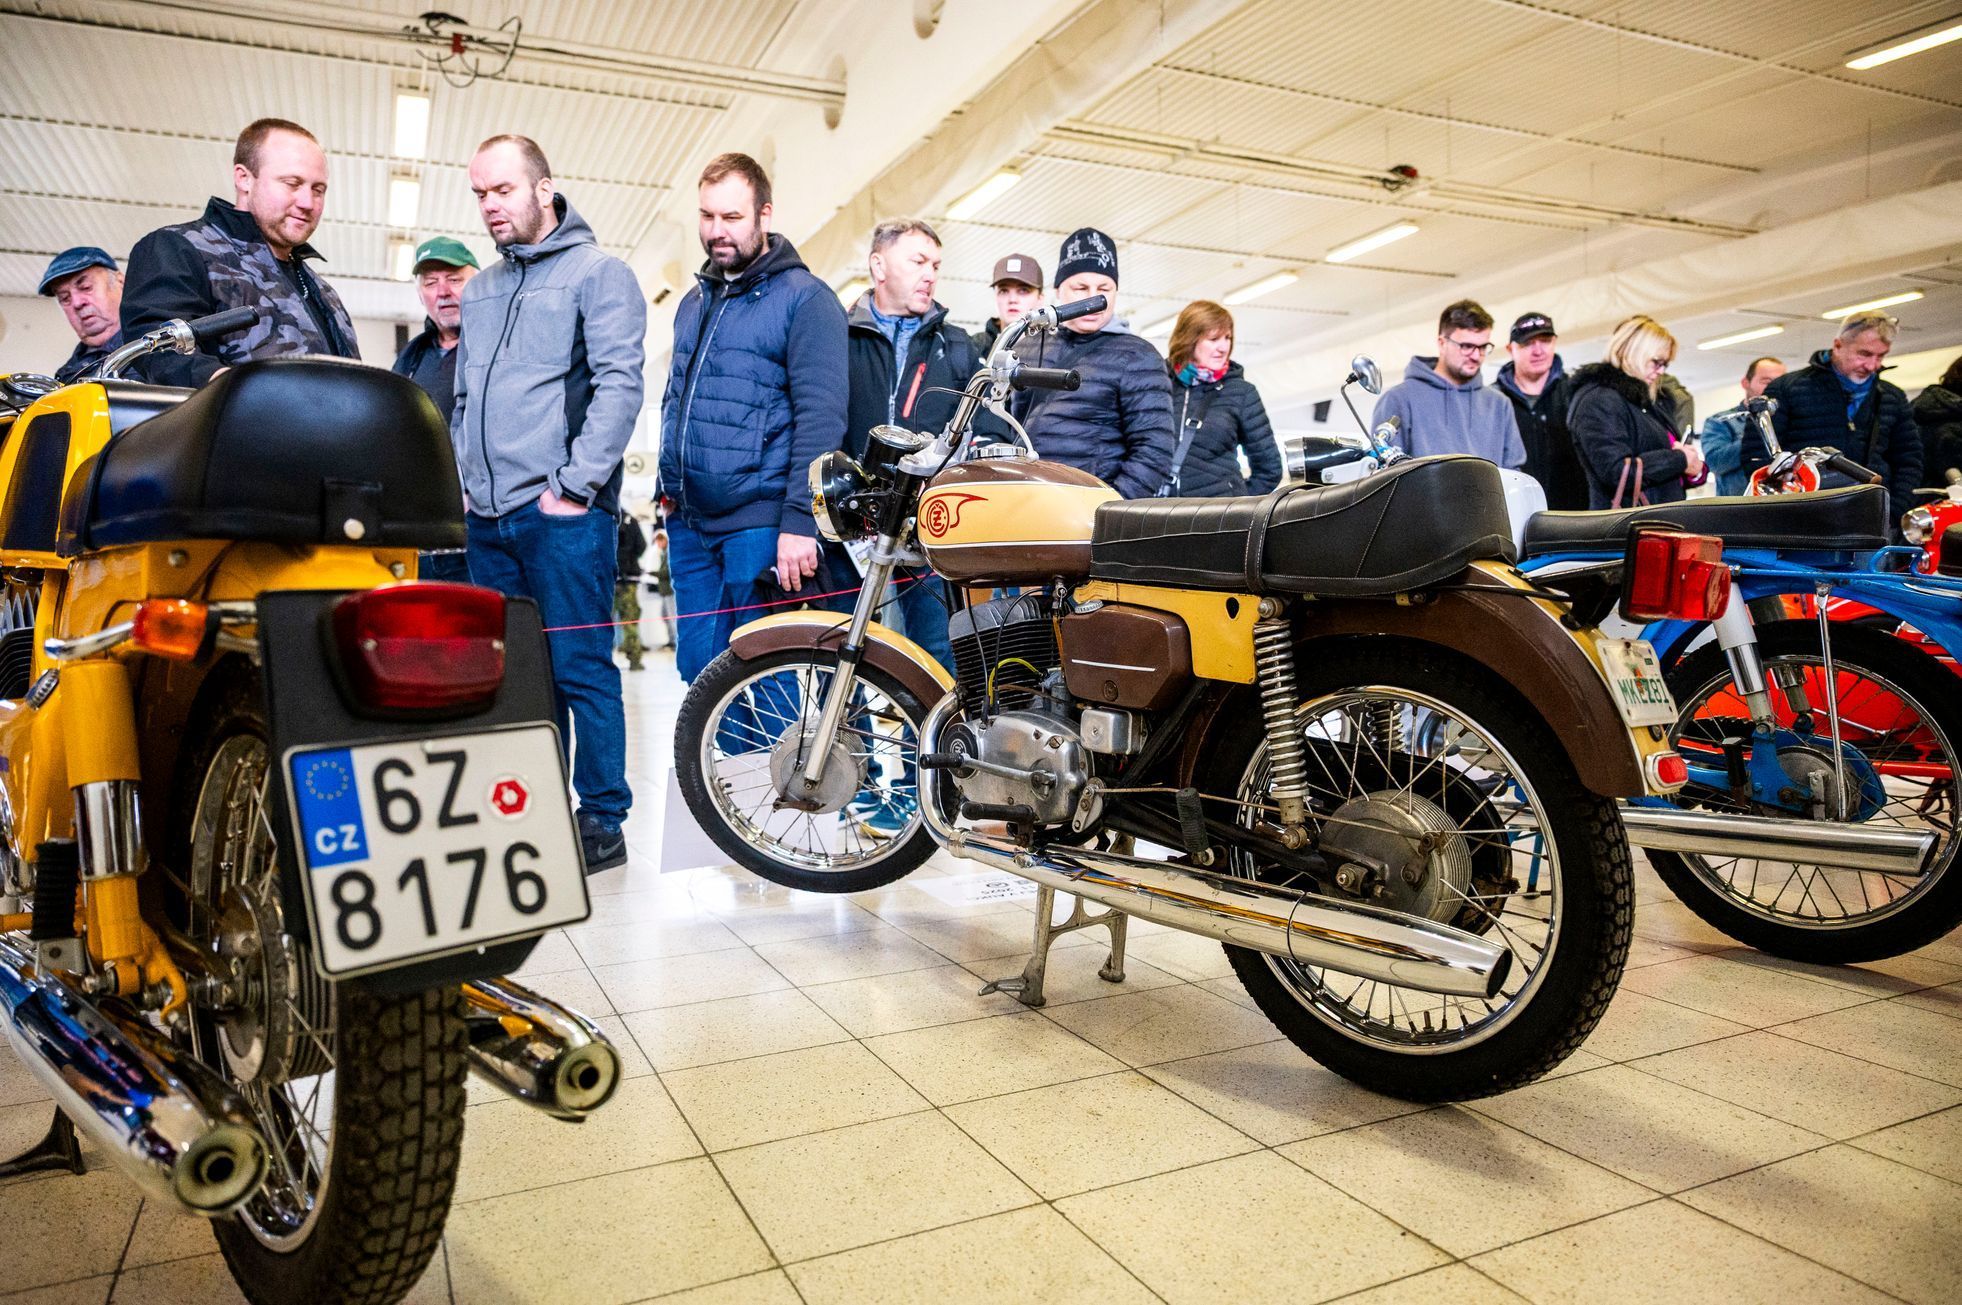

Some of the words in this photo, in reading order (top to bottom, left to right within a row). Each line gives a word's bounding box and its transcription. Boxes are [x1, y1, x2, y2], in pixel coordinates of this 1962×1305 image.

[373, 749, 479, 835] 6Z
[315, 824, 360, 855] CZ
[331, 840, 549, 951] 8176
